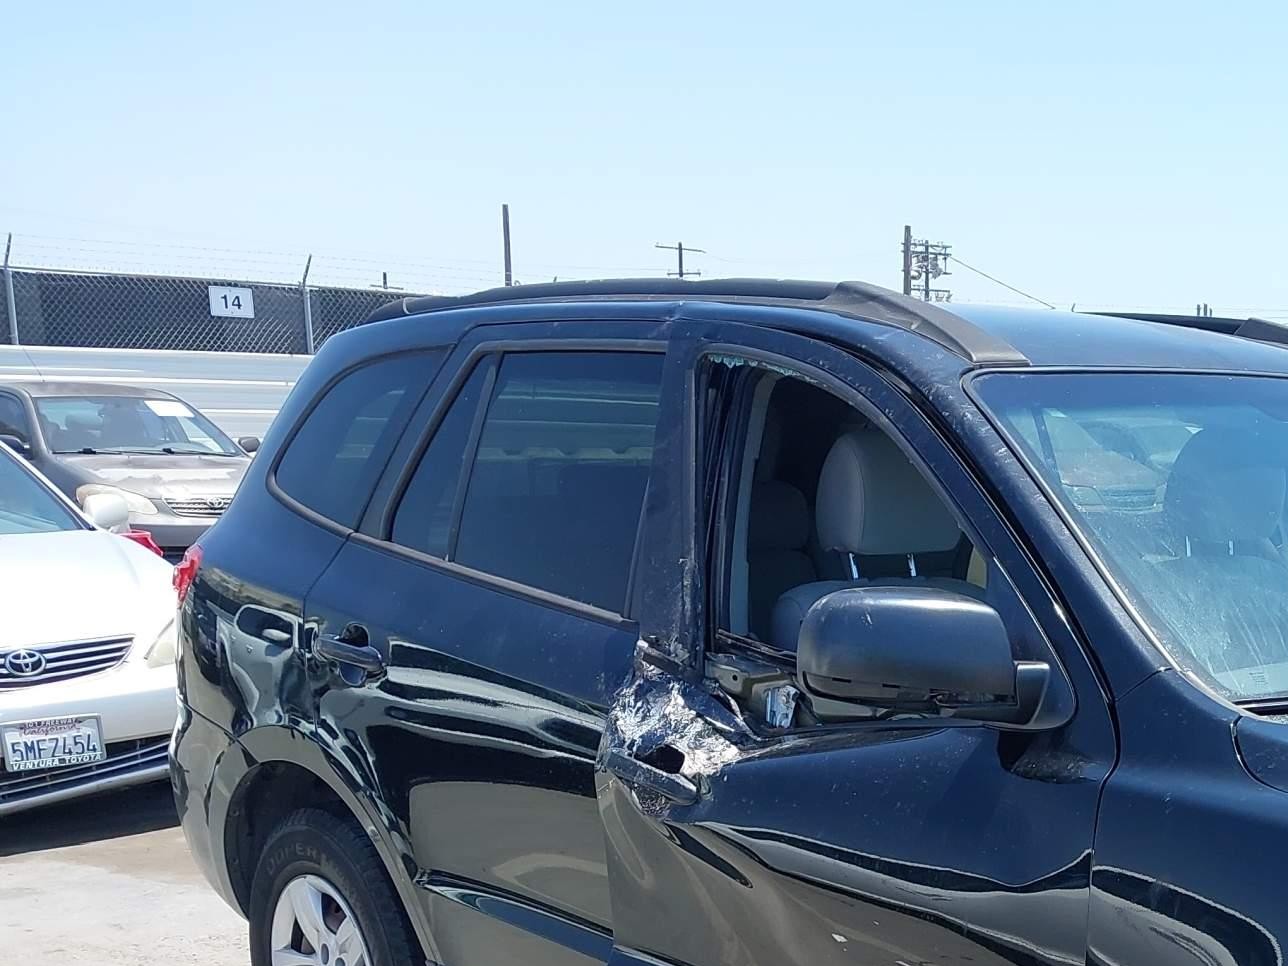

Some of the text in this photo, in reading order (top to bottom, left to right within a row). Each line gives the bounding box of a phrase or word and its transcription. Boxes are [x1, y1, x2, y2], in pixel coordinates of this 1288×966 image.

[221, 294, 242, 310] 14
[12, 754, 101, 770] VENTURA TOYOTA
